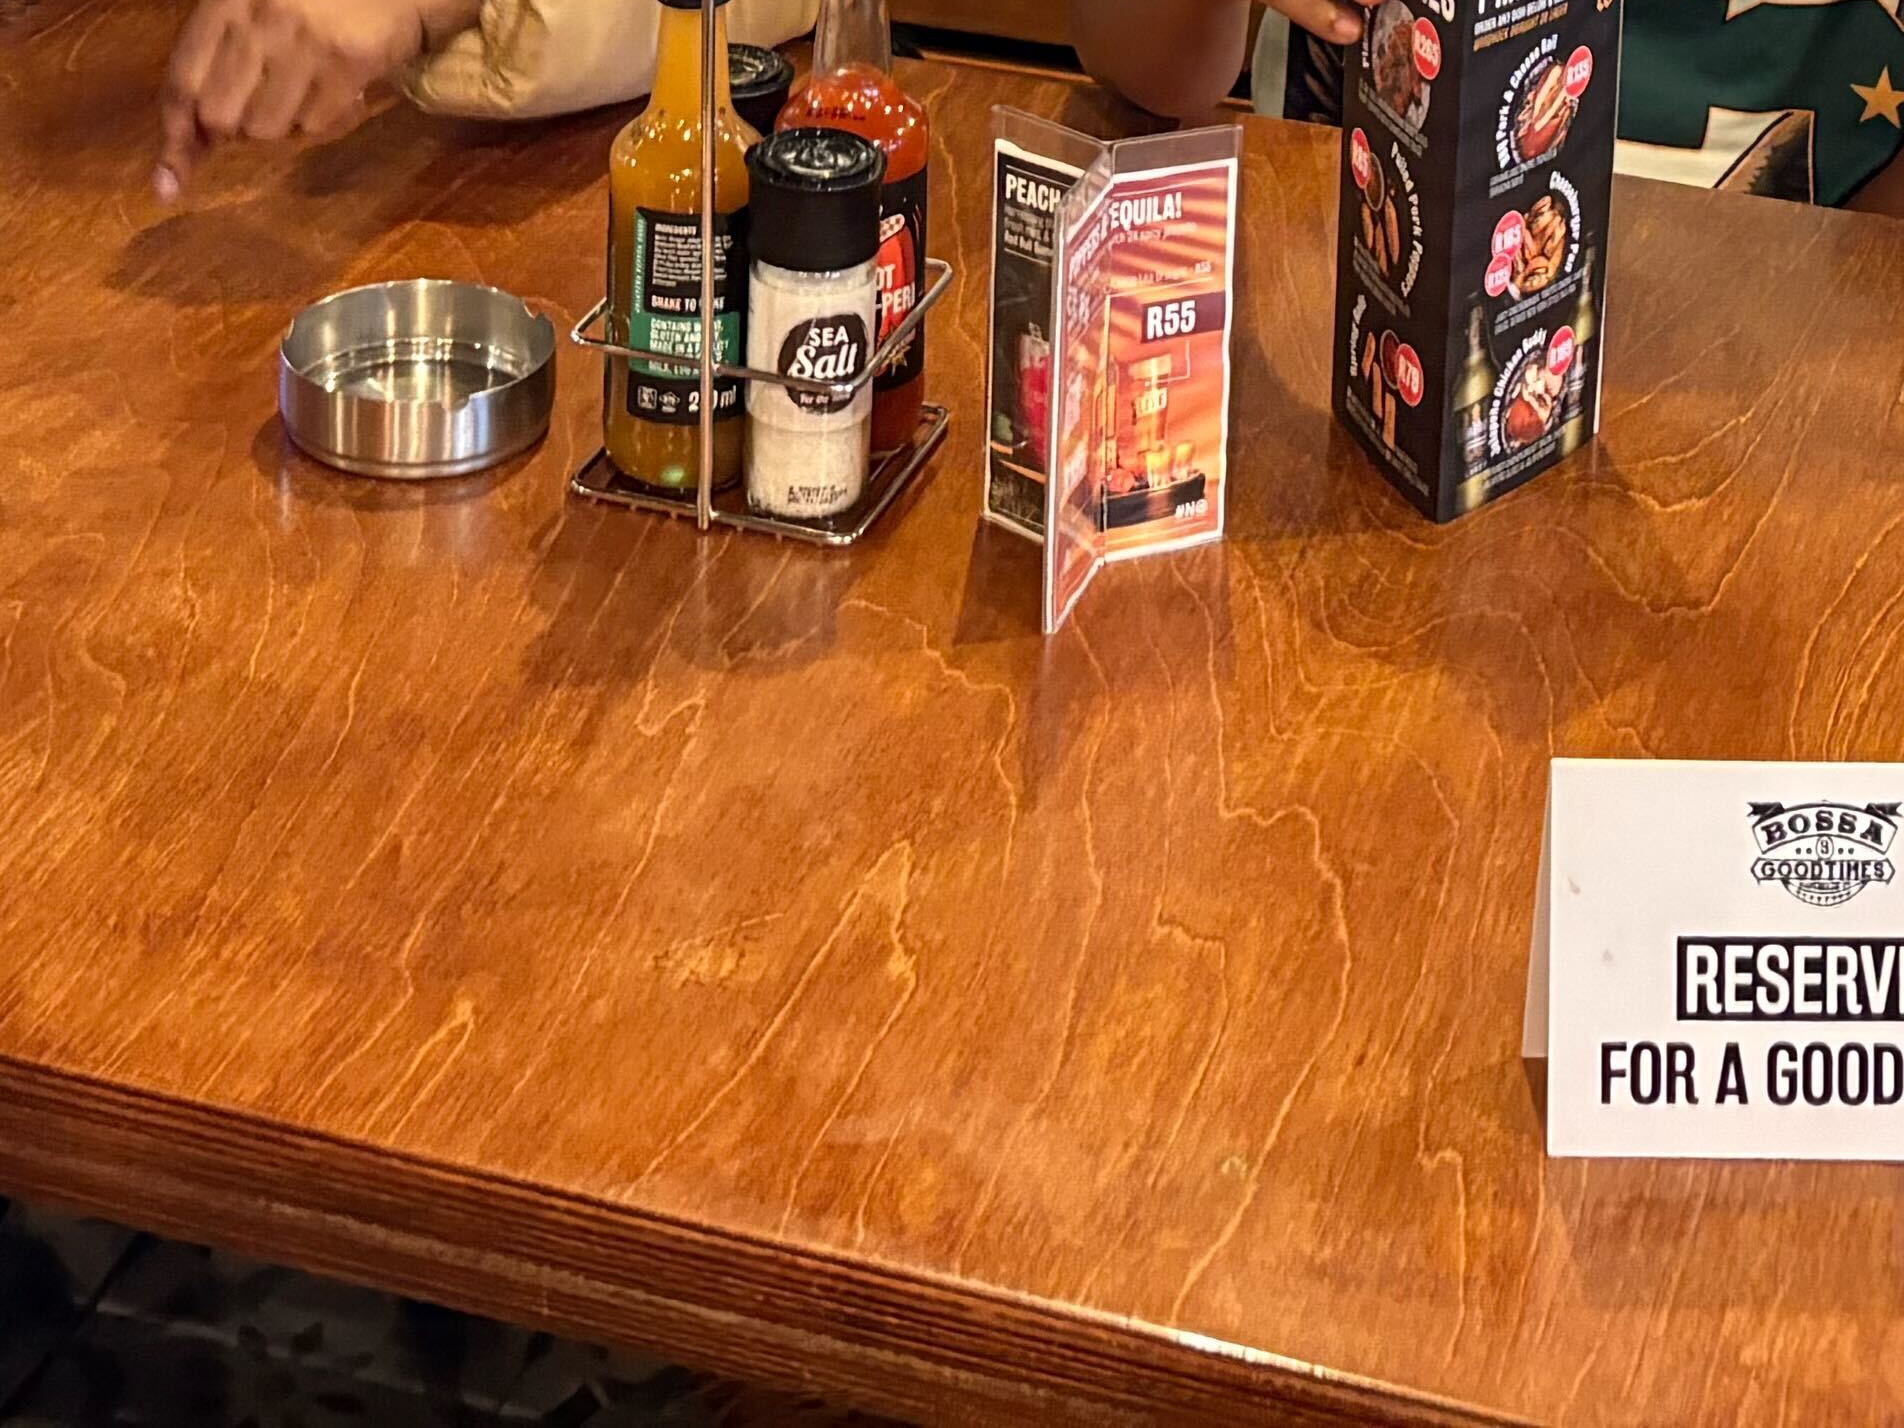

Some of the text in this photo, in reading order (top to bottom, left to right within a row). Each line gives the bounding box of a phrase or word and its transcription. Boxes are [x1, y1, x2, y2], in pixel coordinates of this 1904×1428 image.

[1005, 173, 1061, 213] PEACH
[1391, 142, 1414, 193] Pulled
[1408, 193, 1423, 237] Pork
[1108, 191, 1183, 232] EQUILA!
[876, 263, 896, 291] OT
[651, 295, 682, 311] SHAKE
[684, 298, 697, 312] TO
[876, 281, 916, 318] -PERI
[809, 325, 849, 347] SEA
[1146, 300, 1196, 340] R55
[720, 385, 736, 408] ml
[1761, 810, 1883, 845] BOSSA
[1761, 861, 1885, 881] GOODTIMES
[1600, 1041, 1699, 1105] FOR
[1715, 1041, 1749, 1105] A
[1767, 1041, 1904, 1106] GOOD
